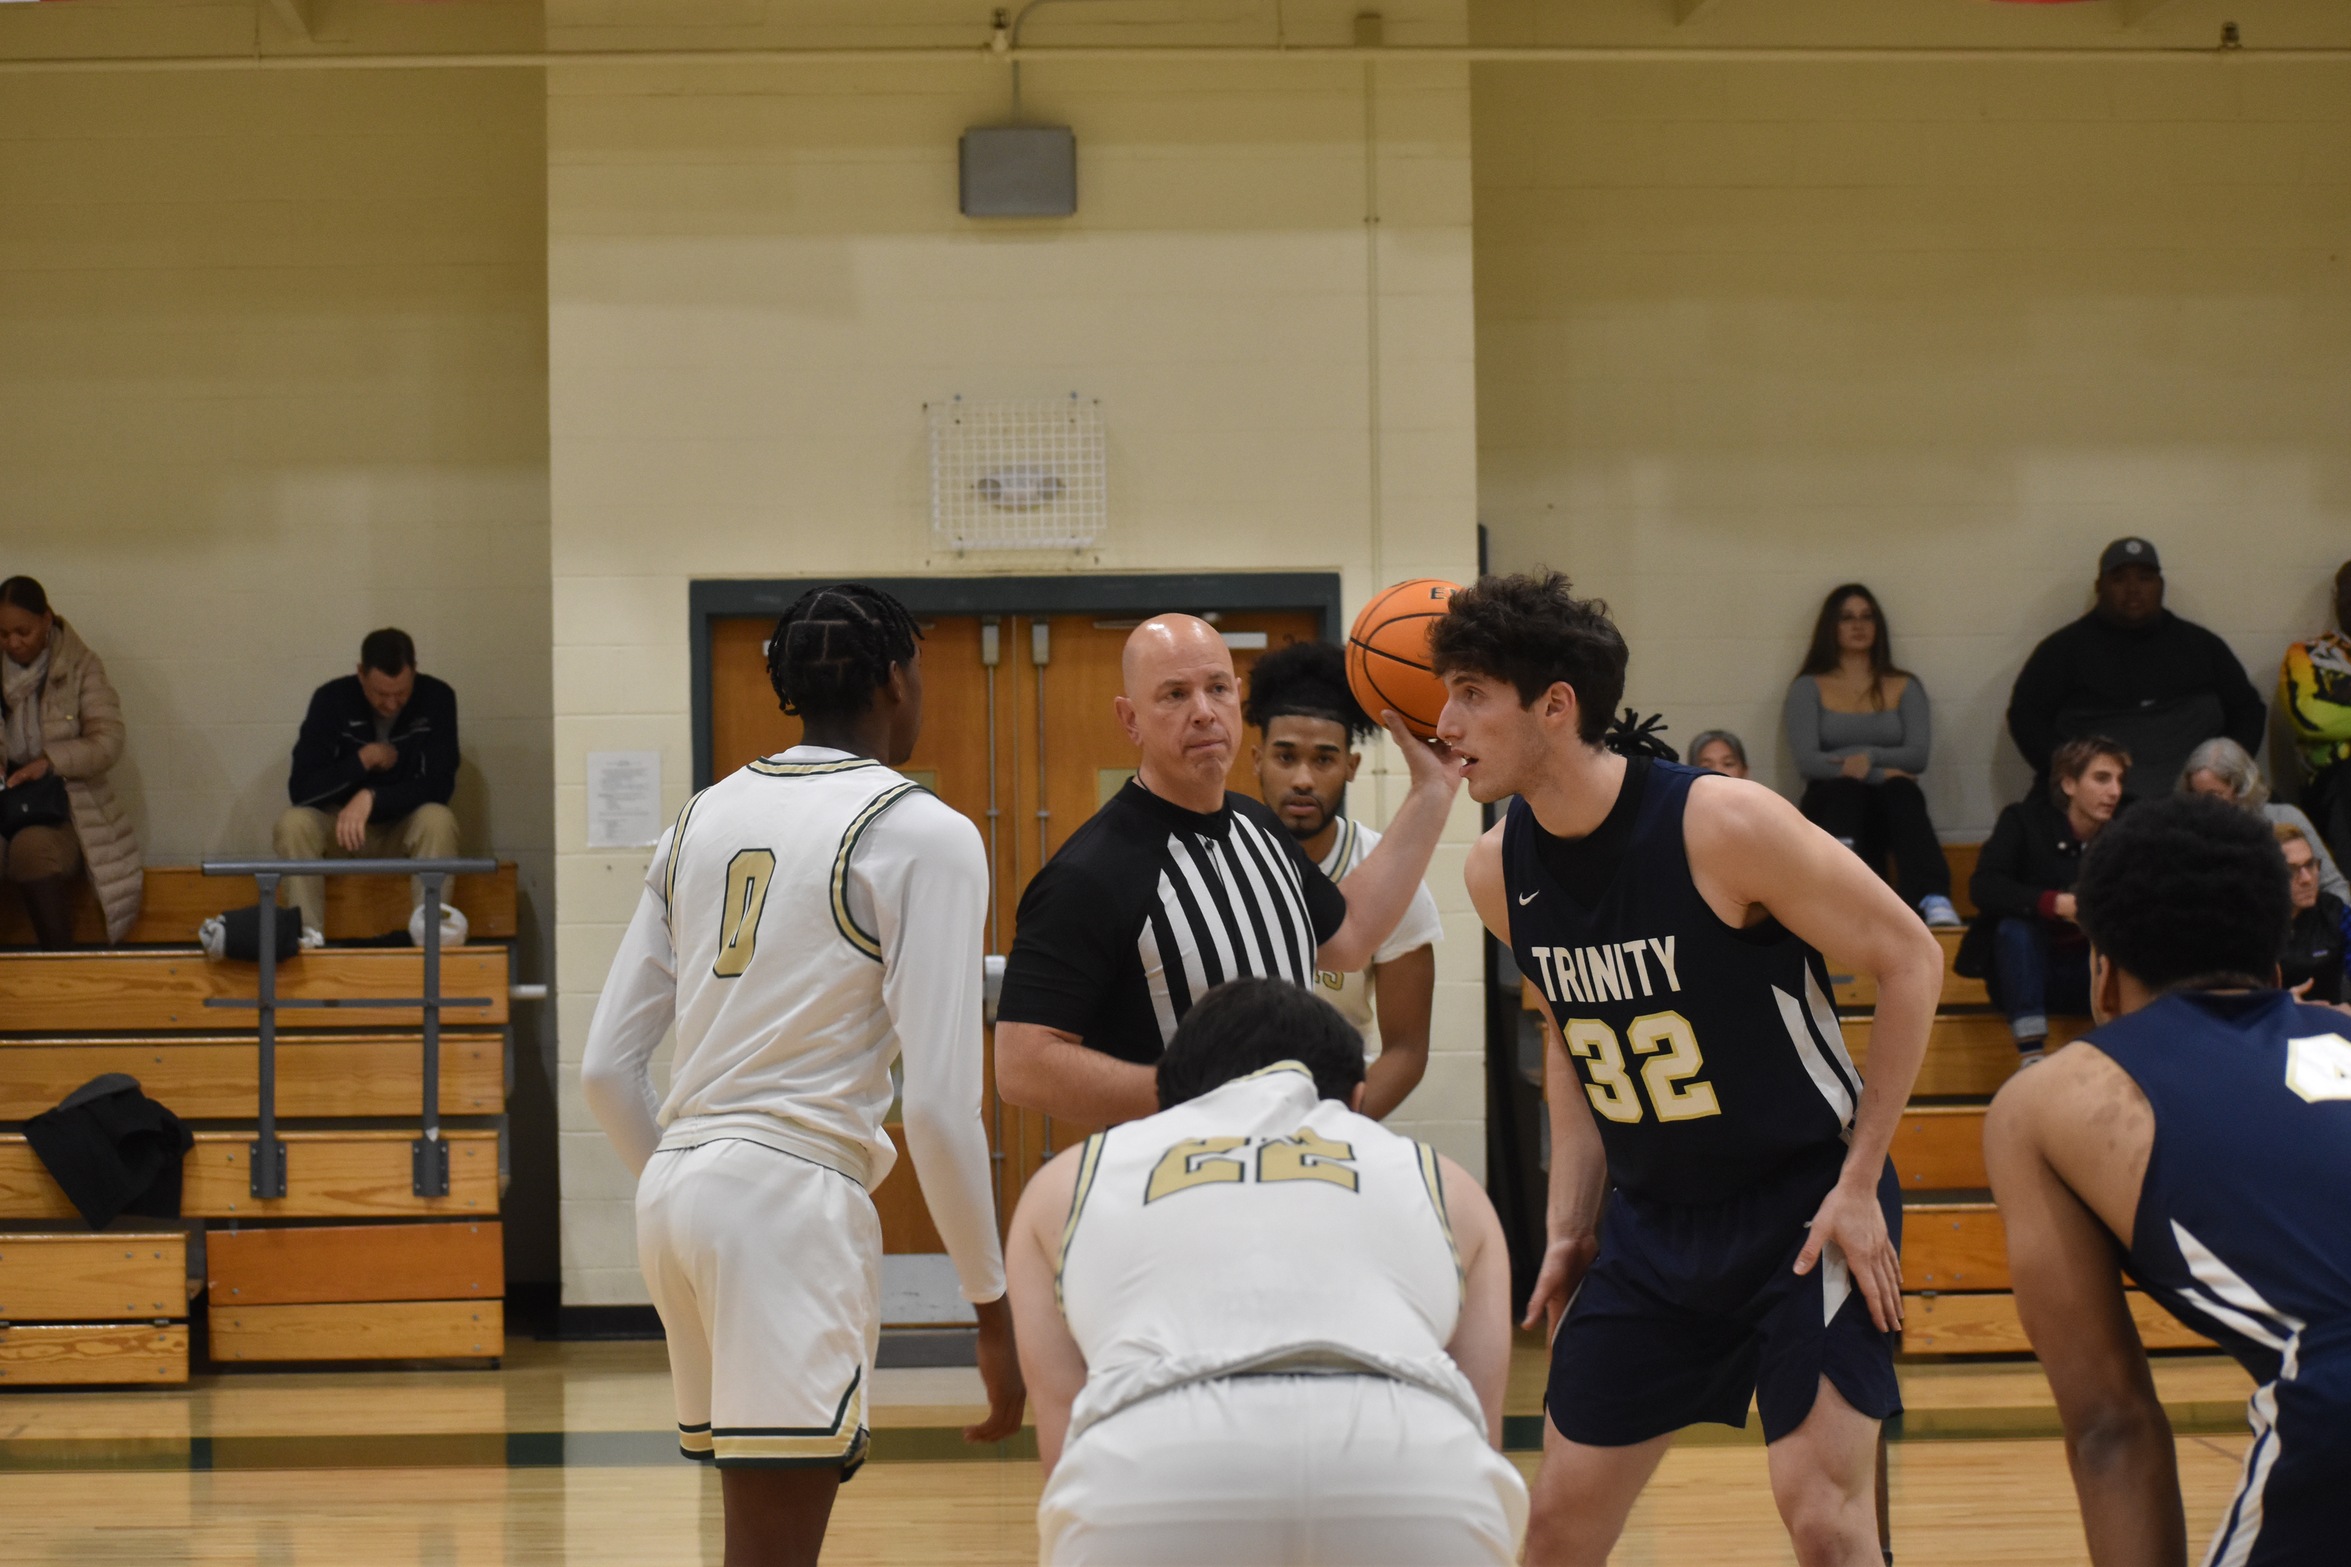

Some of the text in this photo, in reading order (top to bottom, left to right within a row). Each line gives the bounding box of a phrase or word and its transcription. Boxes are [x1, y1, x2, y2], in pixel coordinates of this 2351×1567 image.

[712, 848, 777, 979] 0
[1531, 935, 1682, 1003] TRINITY
[1563, 1009, 1722, 1123] 32
[1143, 1126, 1360, 1206] 22
